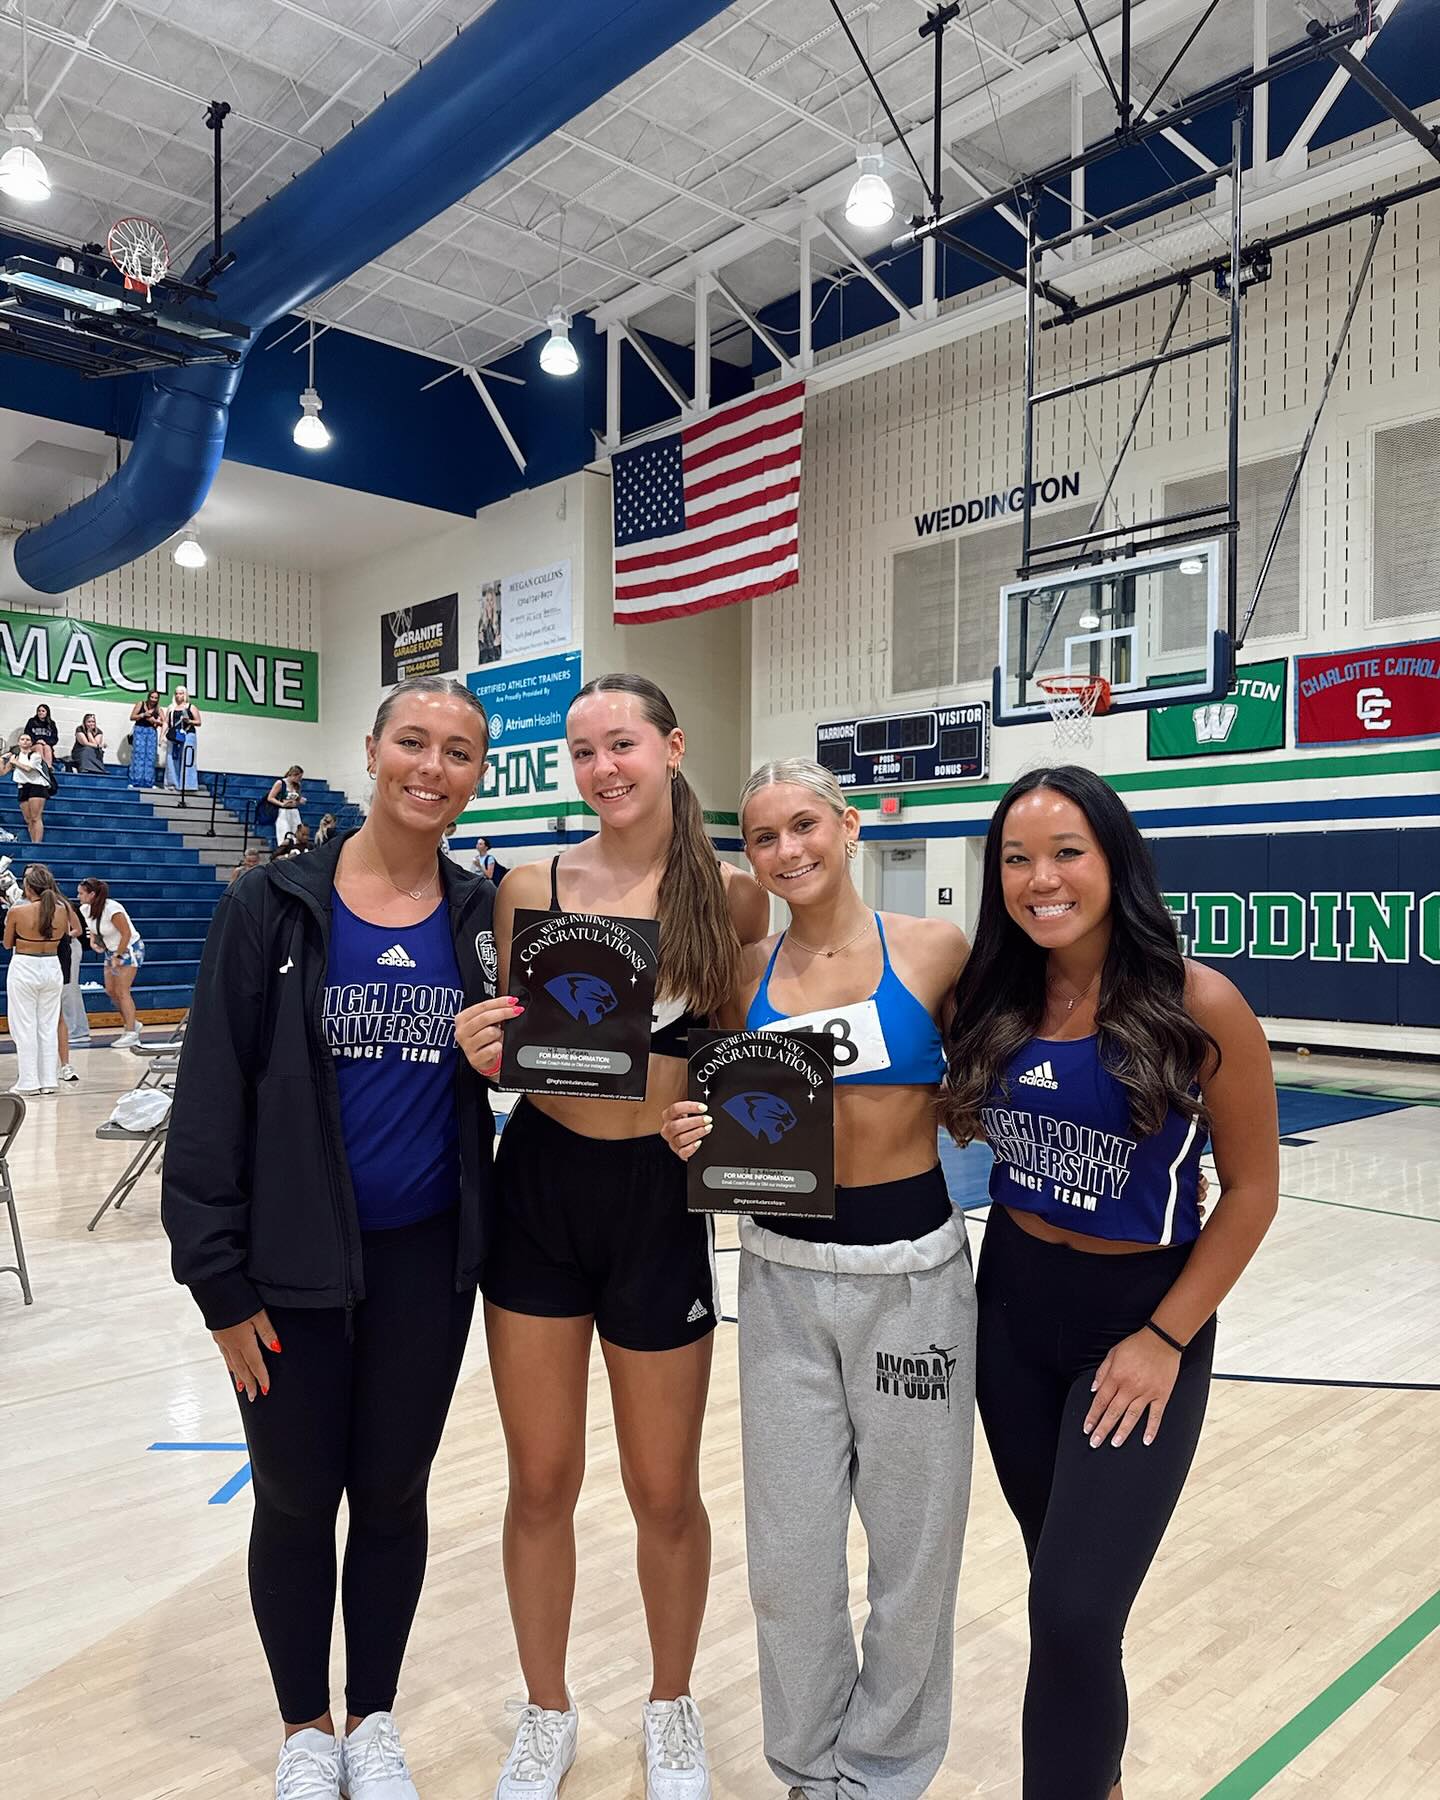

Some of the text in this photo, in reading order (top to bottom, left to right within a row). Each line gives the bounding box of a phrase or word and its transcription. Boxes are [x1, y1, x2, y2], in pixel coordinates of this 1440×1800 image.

[914, 472, 1080, 537] WEDDINGTON
[533, 568, 563, 586] COLLINS
[393, 637, 443, 658] GARAGE FLOORS
[401, 622, 443, 647] GRANITE
[0, 620, 304, 709] MACHINE
[476, 670, 571, 697] CERTIFIED ATHLETIC TRAINERS
[1300, 659, 1381, 698] CHARLOTTE
[495, 687, 550, 703] Are Proudly Provided By
[938, 708, 982, 727] VISITOR
[1192, 704, 1238, 744] W
[818, 724, 855, 741] WARRIORS
[873, 762, 901, 775] PERIOD
[879, 754, 895, 763] POSS
[934, 764, 962, 776] BONUS
[568, 914, 611, 929] INVITING
[610, 921, 631, 941] YOU!
[376, 957, 416, 968] adidas
[520, 927, 647, 972] CONGRATULATIONS!
[322, 983, 388, 1018] IGH
[392, 983, 464, 1017] POIN
[322, 1013, 459, 1049] NIVERSIT
[740, 1031, 784, 1045] INVITING
[783, 1038, 805, 1057] YOU!
[788, 1018, 859, 1067] 8
[331, 1045, 441, 1064] DANCE TEAM
[539, 1052, 552, 1060] FOR
[552, 1053, 570, 1061] MORE
[697, 1045, 823, 1088] CONGRATULATIONS!
[1018, 1074, 1059, 1091] adidas
[1039, 1116, 1137, 1169] POINT
[1009, 1166, 1098, 1211] DANCE TEAM
[687, 1307, 708, 1322] adidas
[876, 1351, 946, 1400] NYCDA
